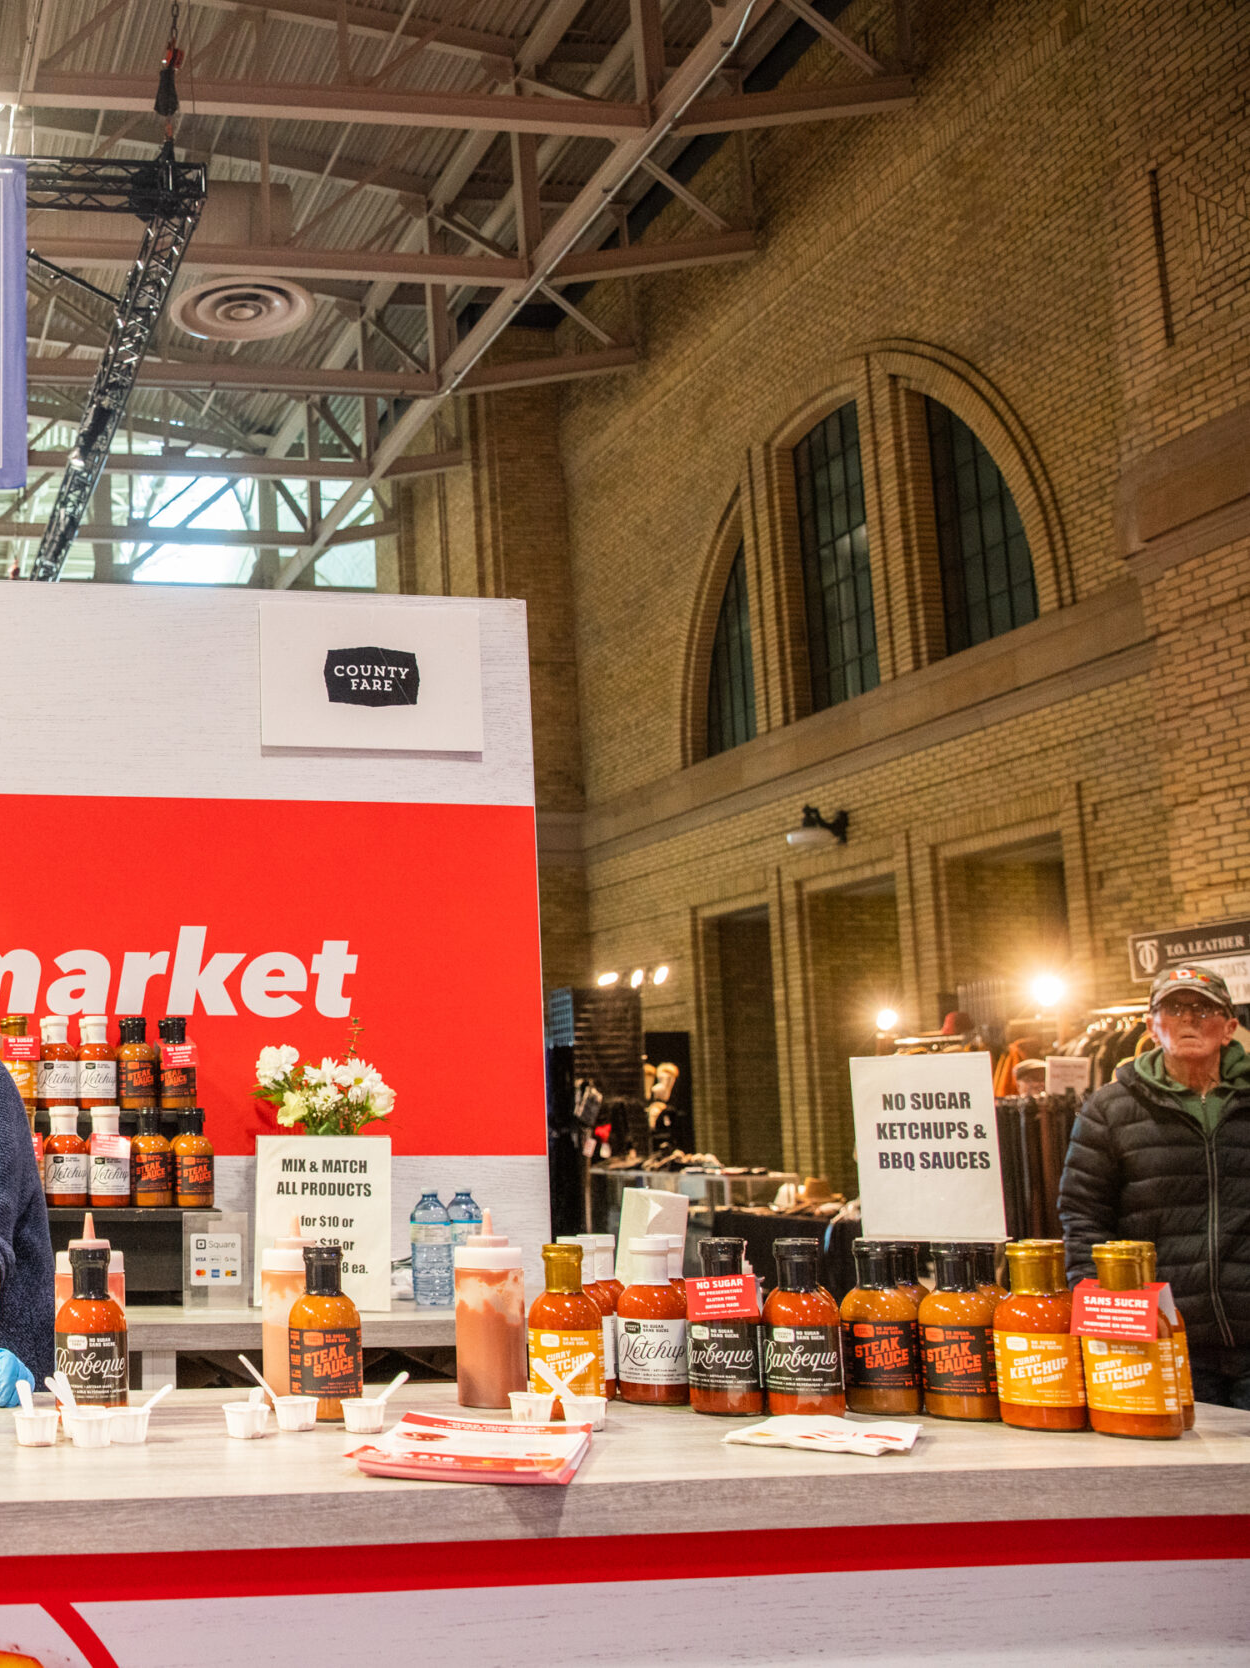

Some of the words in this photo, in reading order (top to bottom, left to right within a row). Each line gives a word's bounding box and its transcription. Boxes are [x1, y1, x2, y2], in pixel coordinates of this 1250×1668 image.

[334, 665, 410, 680] COUNTY
[351, 679, 393, 692] FARE
[1189, 935, 1245, 954] LEATHER
[882, 1093, 906, 1111] NO
[910, 1092, 971, 1110] SUGAR
[876, 1121, 969, 1140] KETCHUPS
[973, 1124, 987, 1139] &
[136, 1162, 161, 1175] STEAK
[281, 1158, 306, 1173] MIX
[309, 1160, 319, 1172] &
[322, 1159, 368, 1174] MATCH
[878, 1151, 915, 1171] BBQ
[919, 1151, 990, 1170] SAUCES
[141, 1168, 166, 1181] SAUCE
[183, 1164, 208, 1177] STEAK
[188, 1171, 211, 1183] SAUCE
[276, 1181, 297, 1196] ALL
[301, 1181, 372, 1197] PRODUCTS
[301, 1215, 316, 1227] for
[320, 1215, 340, 1228] $10
[342, 1218, 354, 1228] or
[208, 1240, 236, 1249] Square
[343, 1241, 355, 1251] or
[351, 1262, 369, 1274] ea.
[696, 1282, 710, 1290] NO
[712, 1278, 744, 1288] SUGAR
[1083, 1296, 1112, 1306] SANS
[1114, 1297, 1149, 1308] SUCRE
[619, 1333, 686, 1367] Ketchup
[854, 1336, 900, 1358] STEAK
[927, 1341, 972, 1362] STEAK
[303, 1344, 348, 1367] STEAK
[546, 1350, 571, 1362] CURRY
[763, 1339, 838, 1373] Barbeque
[865, 1348, 909, 1369] SAUCE
[1013, 1354, 1042, 1366] CURRY
[54, 1347, 125, 1381] Barbeque
[313, 1356, 354, 1378] SAUCE
[935, 1354, 982, 1374] SAUCE
[1010, 1357, 1069, 1379] KETCHUP
[1094, 1359, 1122, 1371] CURRY
[1032, 1376, 1043, 1385] AU
[1043, 1373, 1063, 1384] CURRY
[1091, 1362, 1152, 1384] KETCHUP
[1112, 1381, 1122, 1391] AU
[1123, 1379, 1146, 1390] CURRY
